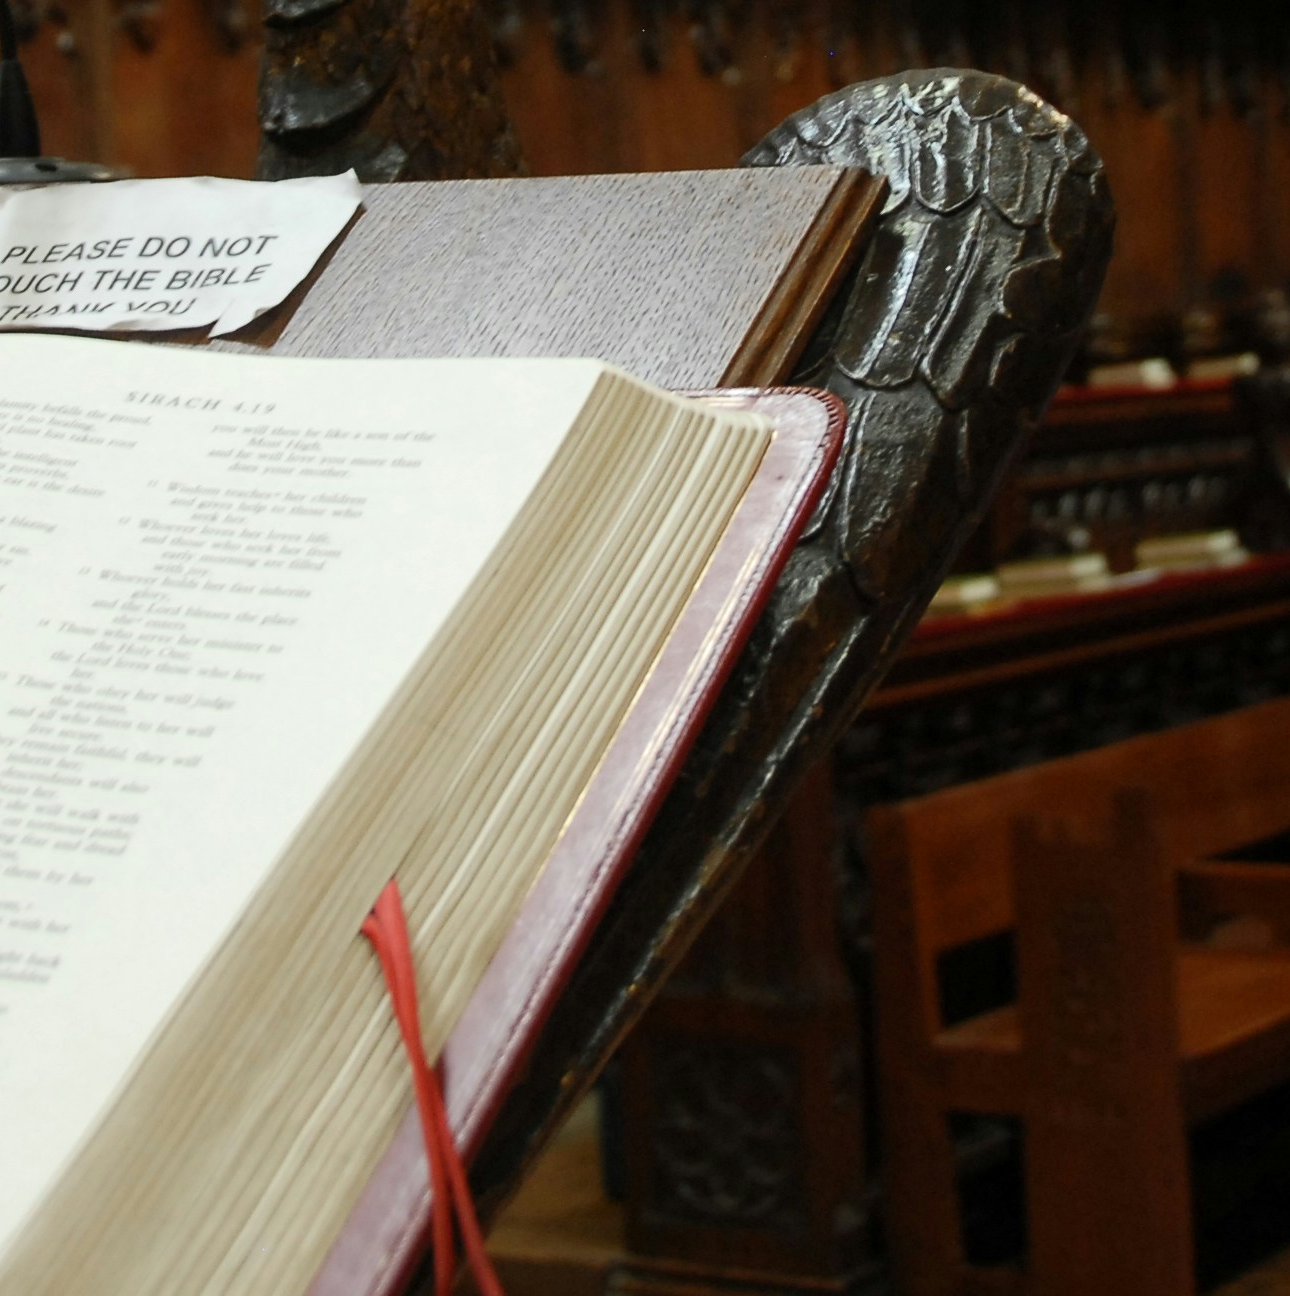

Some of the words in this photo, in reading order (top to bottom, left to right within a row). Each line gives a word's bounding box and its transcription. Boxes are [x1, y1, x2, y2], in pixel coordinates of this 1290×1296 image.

[0, 236, 134, 264] PLEASE
[138, 236, 193, 257] DO
[198, 235, 279, 257] NOT
[92, 270, 161, 291] THE
[165, 263, 272, 290] BIBLE
[127, 298, 197, 315] YOU
[125, 390, 221, 411] SIRACH
